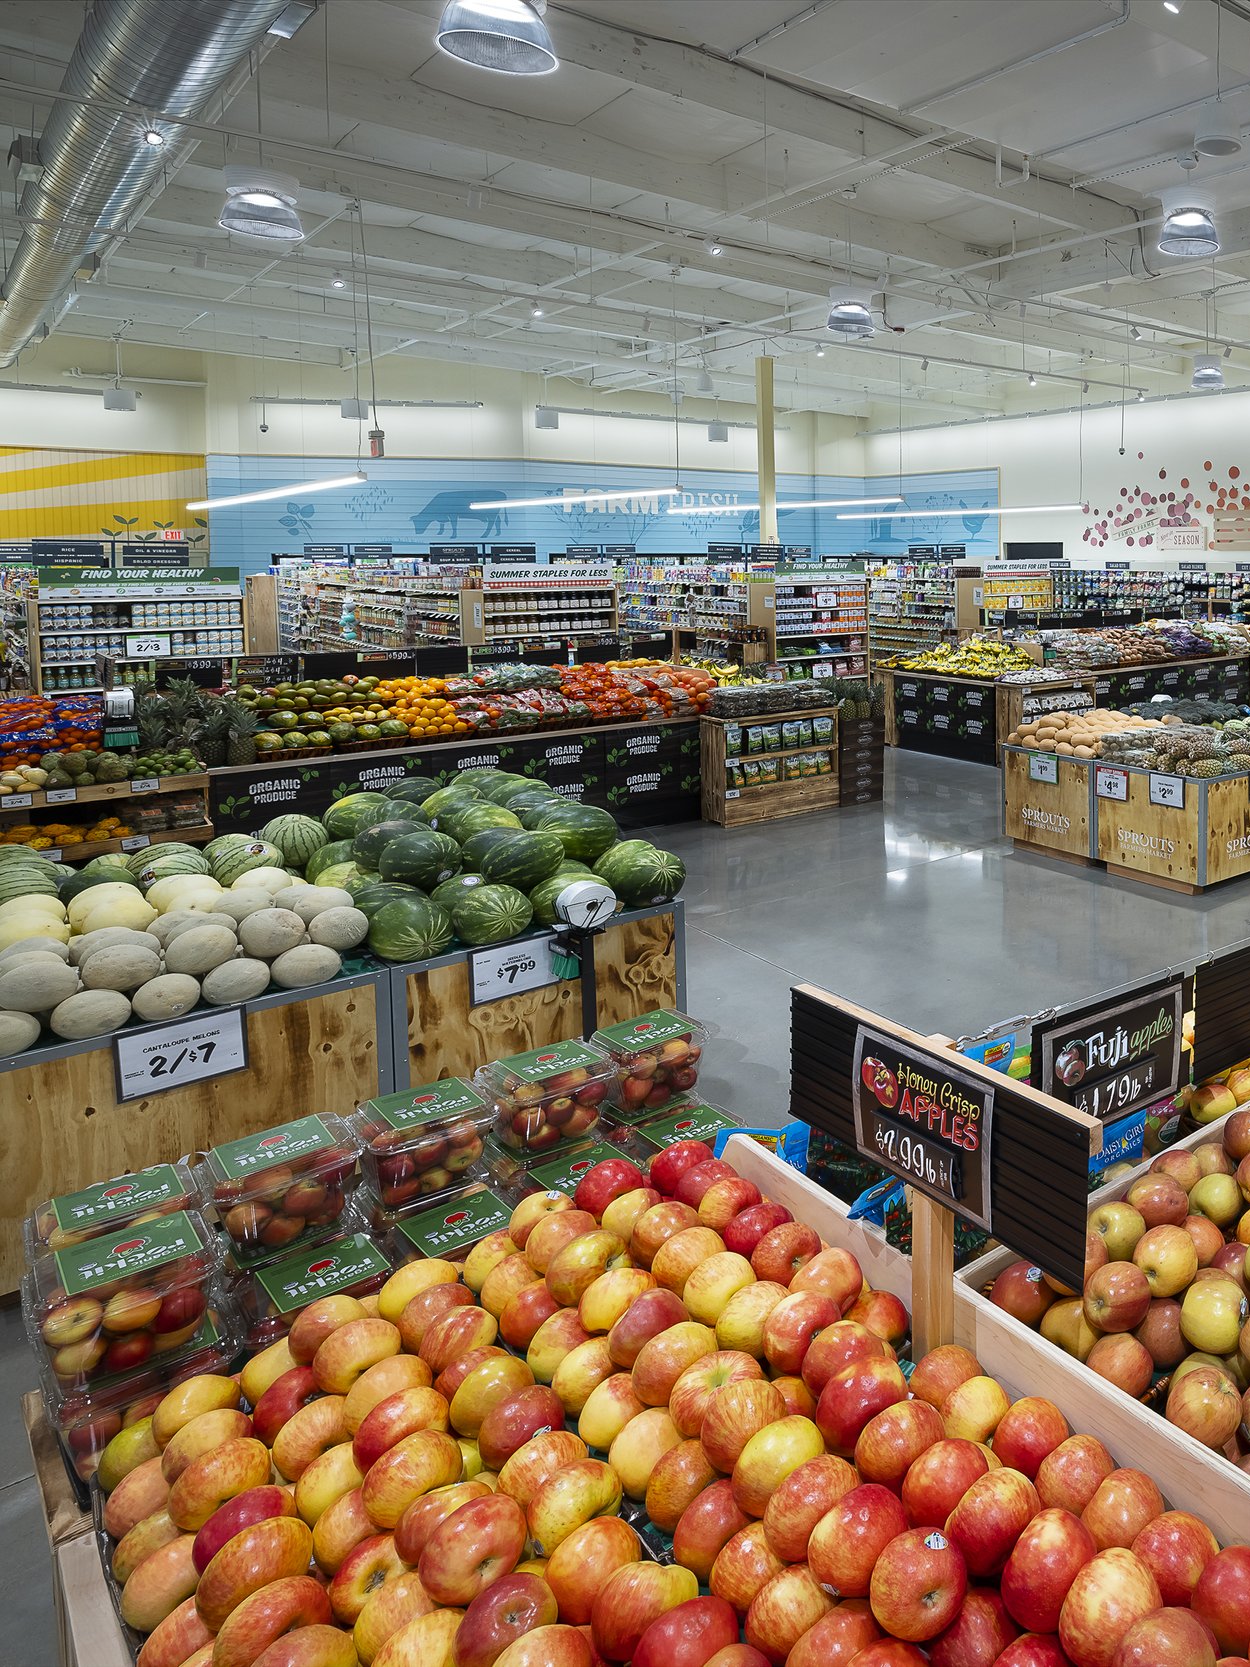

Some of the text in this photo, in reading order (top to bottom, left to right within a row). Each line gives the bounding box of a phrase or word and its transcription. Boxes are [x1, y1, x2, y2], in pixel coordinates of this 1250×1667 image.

[563, 488, 739, 516] FARM FRESH
[165, 531, 181, 540] EXIT
[1174, 535, 1200, 545] SEASON
[80, 569, 205, 579] FIND YOUR HEALTHY
[489, 569, 608, 579] SUMMER STAPLES FOR LESS
[827, 562, 849, 570] HEALTHY
[545, 744, 583, 759] ORGANIC
[626, 735, 661, 748] ORGANIC
[629, 744, 658, 755] PRODUCE
[457, 754, 500, 770] ORGANIC
[549, 754, 581, 767] PRODUCE
[358, 766, 406, 782] ORGANIC
[627, 773, 661, 786] ORGANIC
[248, 778, 301, 796] ORGANIC
[253, 791, 297, 805] PRODUCE
[552, 783, 585, 796] RGANIC
[629, 782, 659, 794] PRODUCE
[1021, 807, 1070, 829] SPROUTS
[1117, 829, 1175, 853] SPROUTS
[142, 1029, 221, 1054] CANTALOUPE MELONS
[622, 1022, 682, 1044] rockit
[1129, 1007, 1173, 1061] apples
[148, 1041, 217, 1078] 2/$7
[522, 1053, 589, 1076] rockit
[897, 1062, 980, 1125] Honey Crisp
[394, 1094, 469, 1121] rockit
[899, 1090, 979, 1152] APPLES
[233, 1134, 320, 1167] rockit
[1095, 1137, 1123, 1160] DAISY
[1104, 1137, 1141, 1164] ORGANICS
[70, 1183, 169, 1219] rockit
[423, 1209, 503, 1245] rockit
[77, 1237, 185, 1280] rockit
[283, 1257, 373, 1298] rockit
